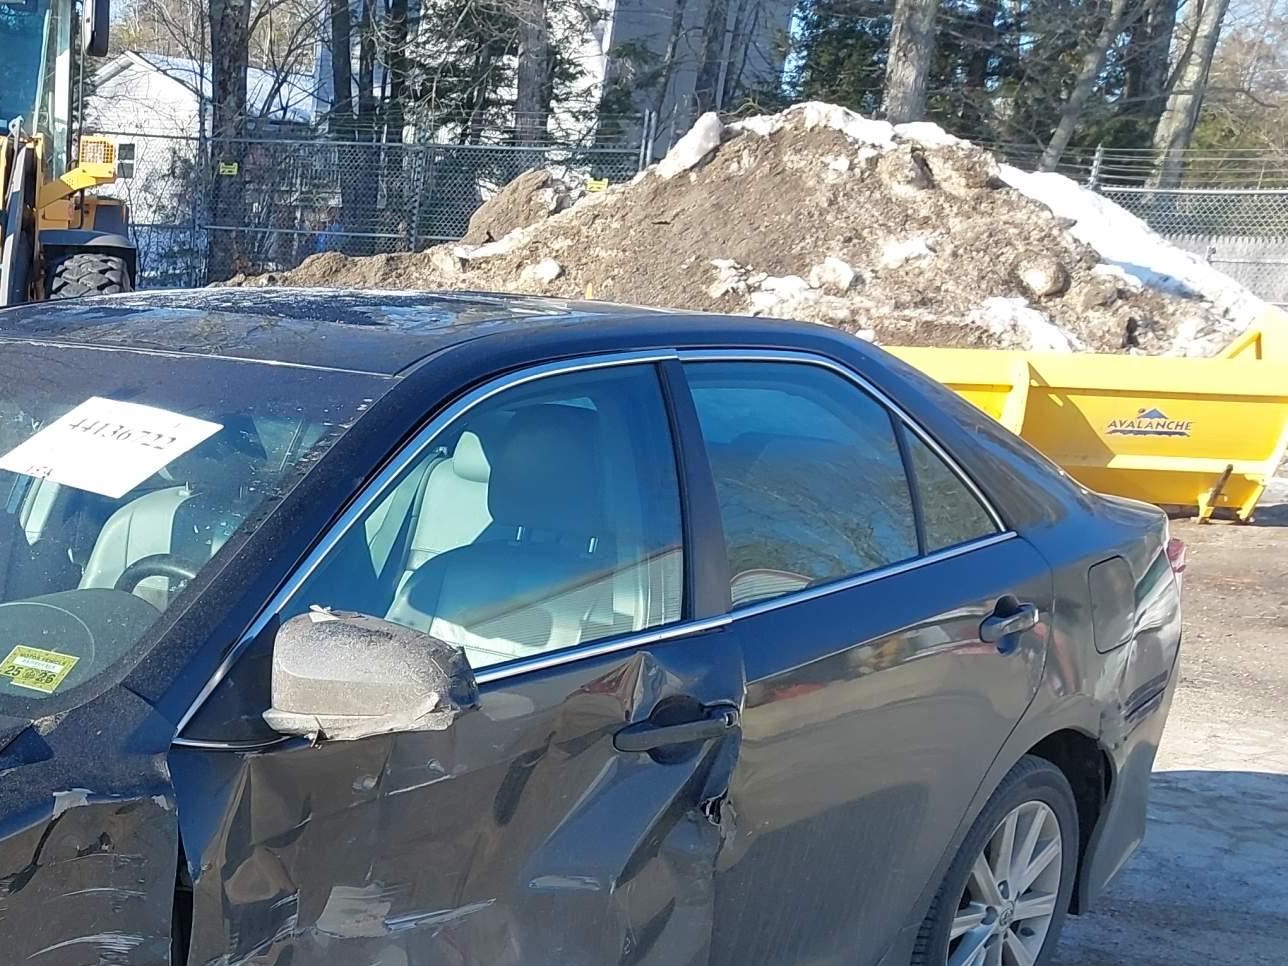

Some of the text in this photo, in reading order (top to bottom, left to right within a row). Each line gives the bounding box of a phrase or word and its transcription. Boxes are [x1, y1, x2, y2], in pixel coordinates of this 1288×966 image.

[68, 417, 177, 450] 44136722
[1107, 419, 1194, 431] AVALANCHE
[4, 665, 56, 684] 25 26
